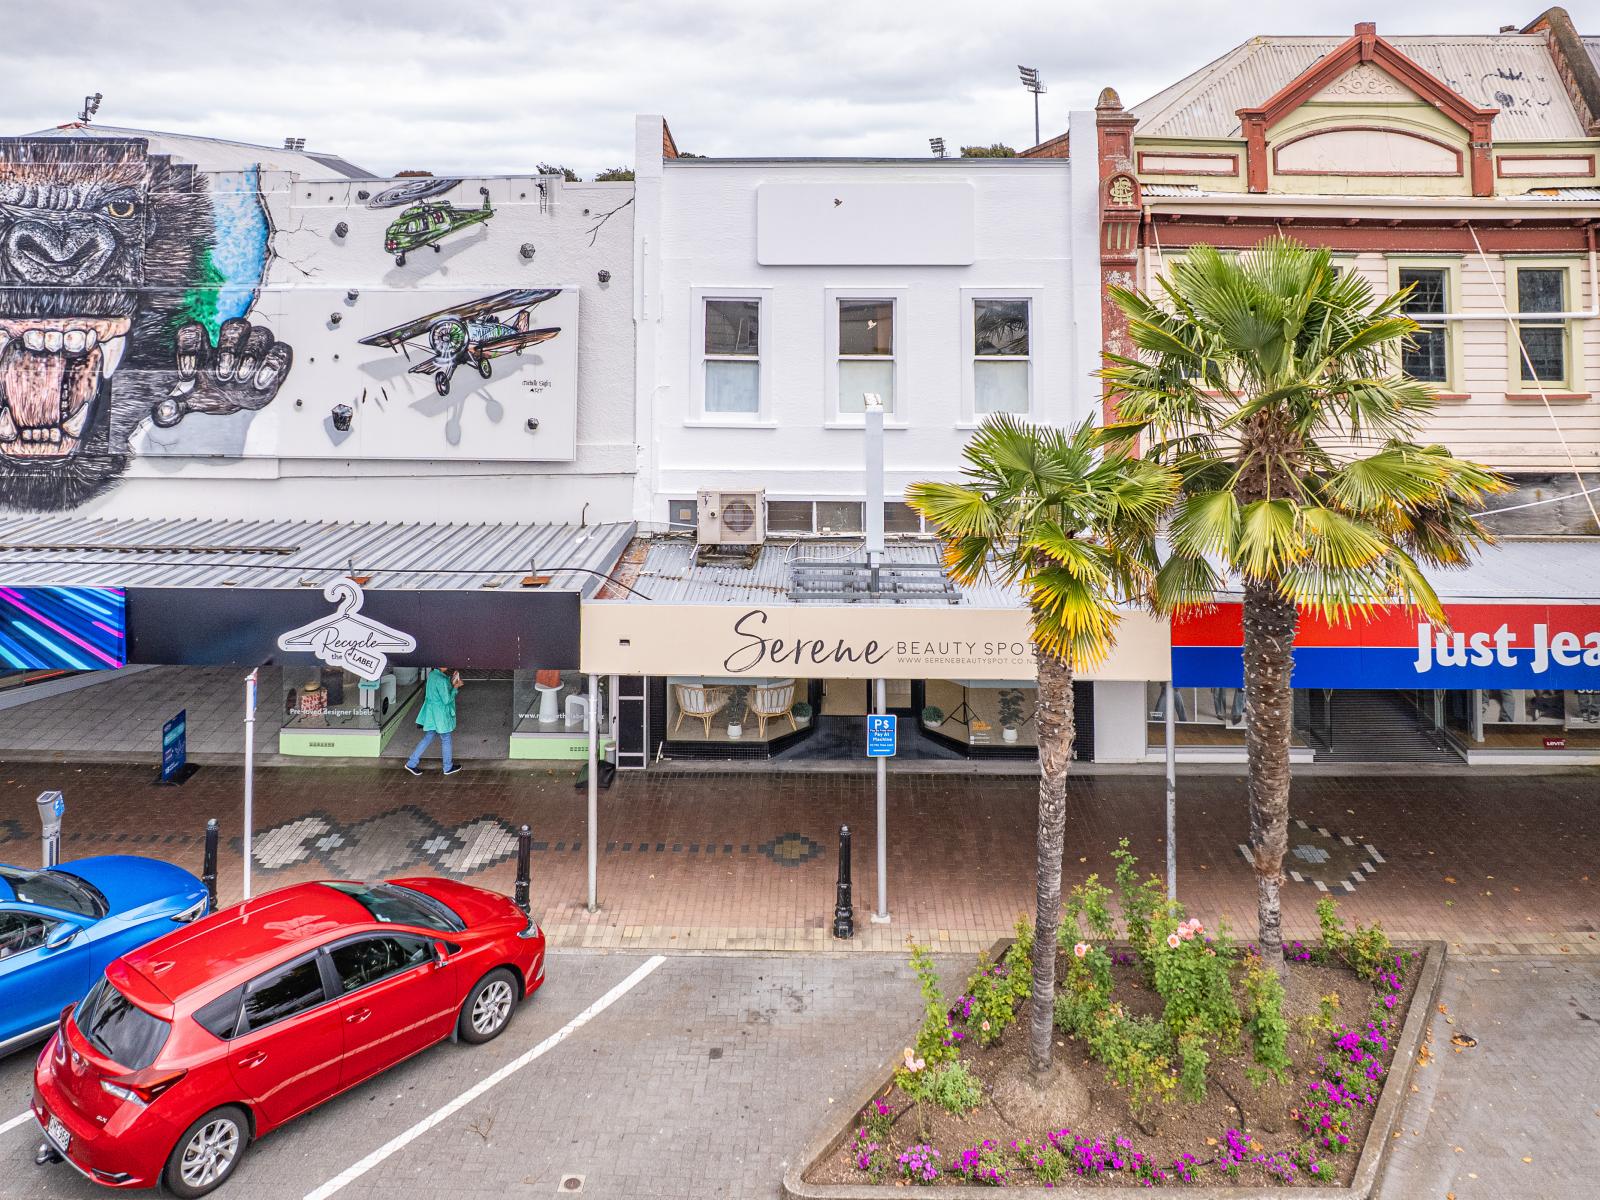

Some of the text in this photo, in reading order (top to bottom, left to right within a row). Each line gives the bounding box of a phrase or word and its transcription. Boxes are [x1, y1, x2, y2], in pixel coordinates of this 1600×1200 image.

[311, 626, 378, 656] Recycle
[724, 609, 1039, 673] Serene BEAUTY SPOT
[1413, 623, 1517, 673] Just
[331, 652, 374, 669] the LABEL
[323, 708, 352, 717] designer
[353, 708, 373, 716] labels
